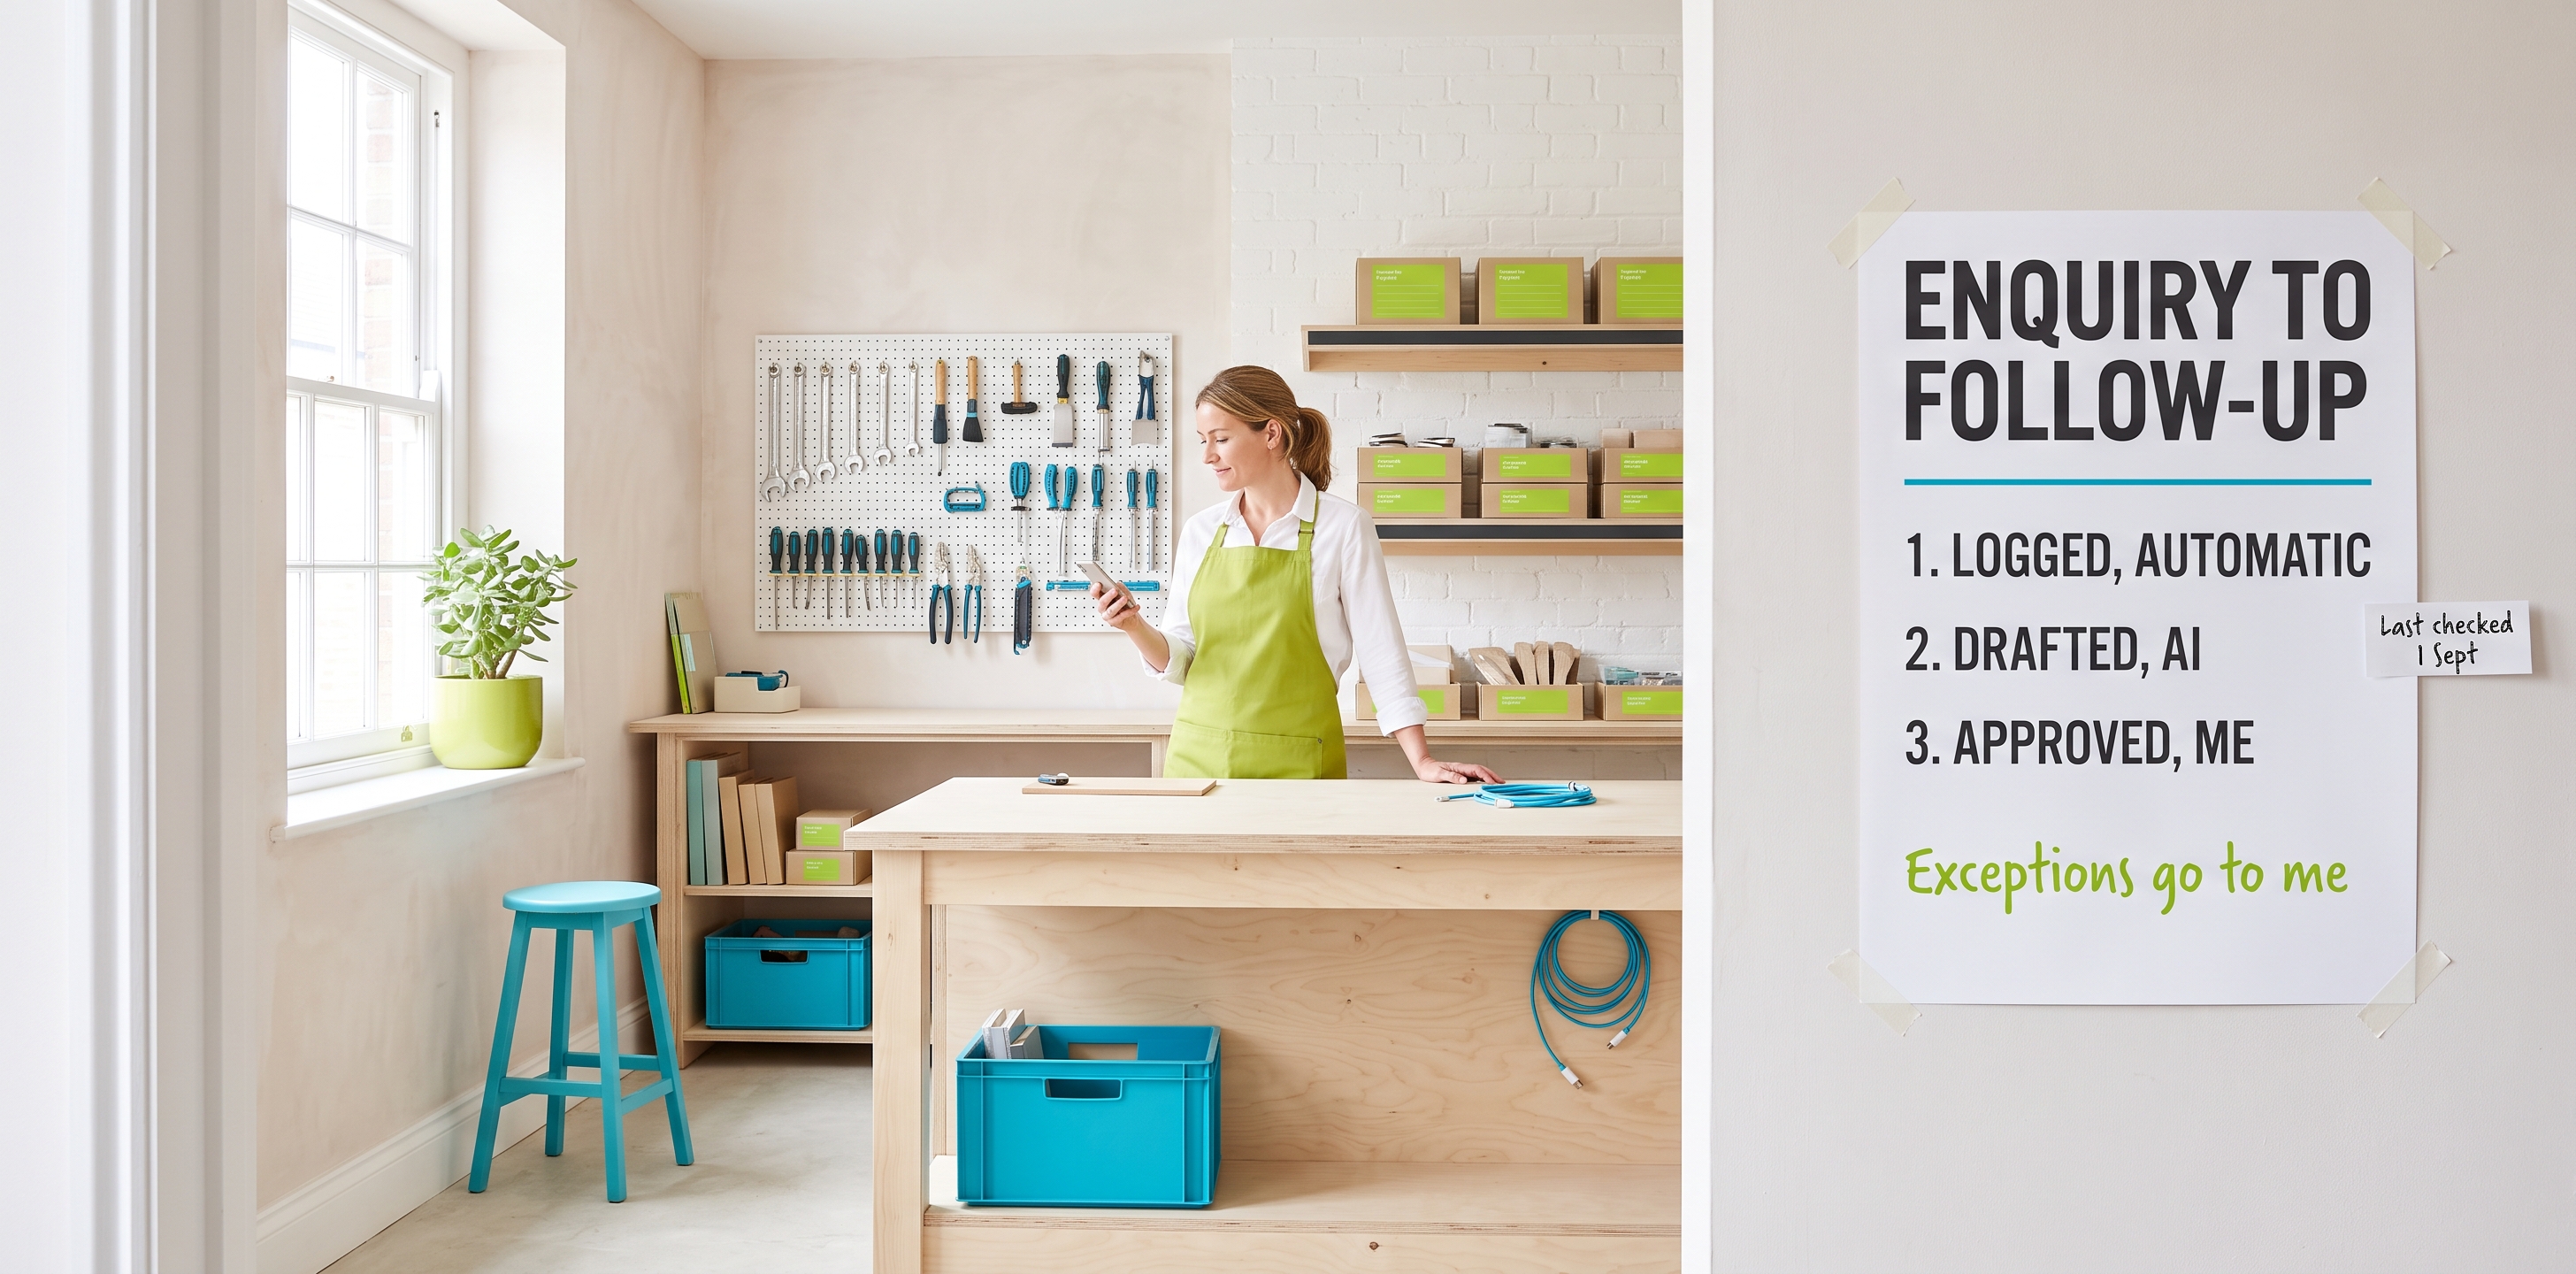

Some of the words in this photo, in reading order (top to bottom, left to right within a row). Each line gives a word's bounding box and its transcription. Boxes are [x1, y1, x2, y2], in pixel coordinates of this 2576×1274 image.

[1906, 260, 2251, 349] ENQUIRY
[2273, 260, 2371, 342] TO
[1906, 360, 2367, 441] FOLLOW-UP
[1907, 533, 1938, 577] 1.
[1953, 533, 2121, 585] LOGGED,
[2135, 533, 2371, 578] AUTOMATIC
[2380, 612, 2424, 638] Last
[2433, 610, 2514, 634] checked
[1905, 626, 1941, 671] 2.
[1954, 626, 2149, 679] DRAFTED,
[2162, 626, 2200, 671] AI
[2418, 644, 2423, 666] 1
[2434, 641, 2479, 674] Sept
[1905, 720, 1940, 764] 3.
[1953, 720, 2181, 772] APPROVED,
[2196, 720, 2255, 764] ME
[1905, 840, 2134, 914] Exceptions
[2152, 863, 2203, 915] go
[2220, 840, 2264, 893] to
[2283, 862, 2349, 893] me
